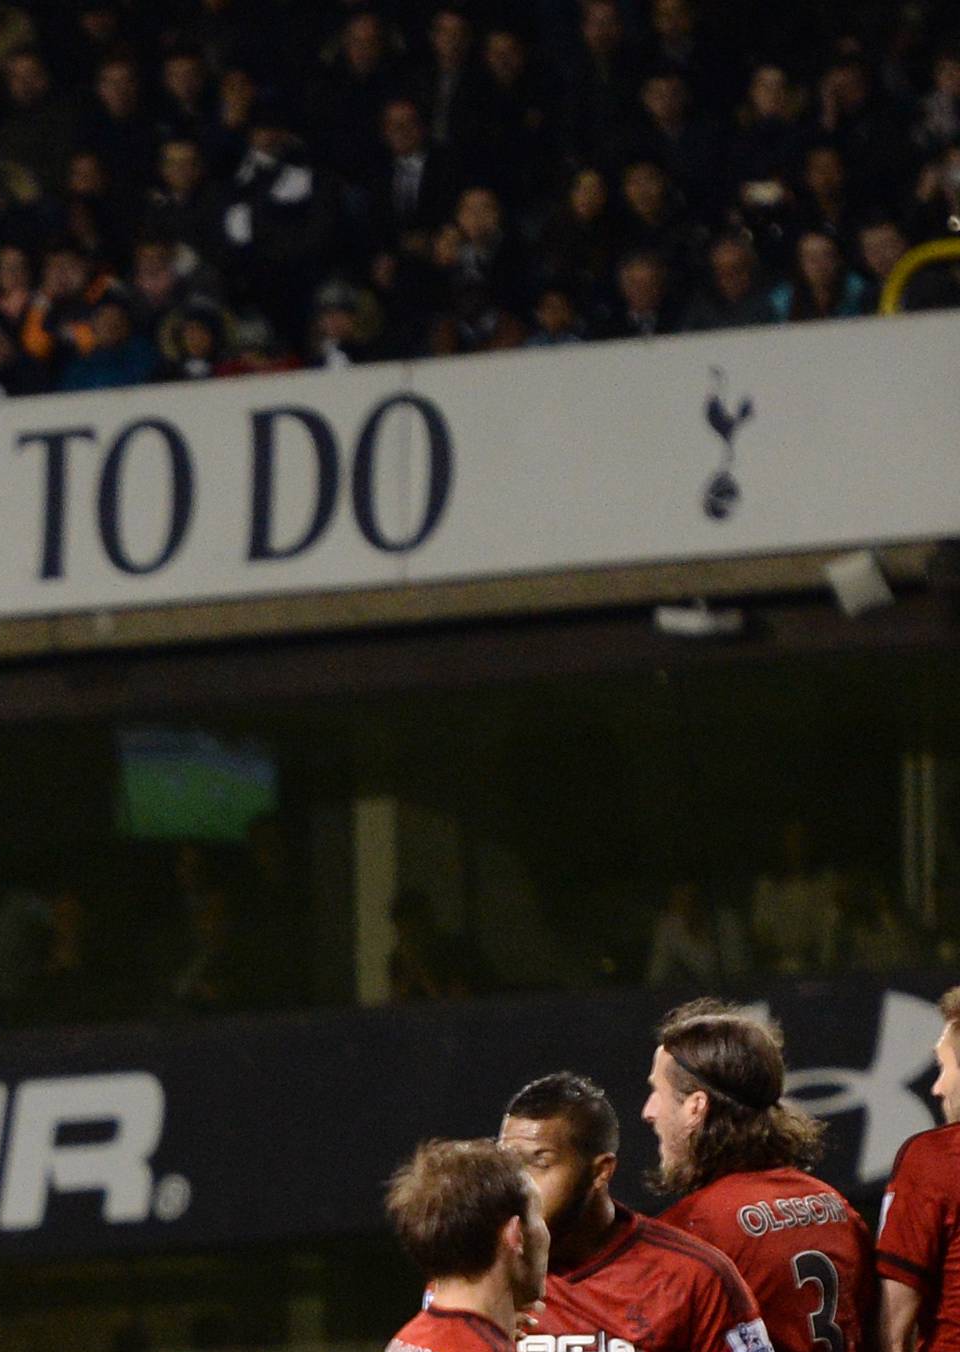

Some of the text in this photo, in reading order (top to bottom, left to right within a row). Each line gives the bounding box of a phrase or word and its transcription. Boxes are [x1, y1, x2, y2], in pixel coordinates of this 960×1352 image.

[16, 414, 196, 581] TO
[246, 390, 455, 563] DO
[736, 1193, 848, 1237] OLSSON
